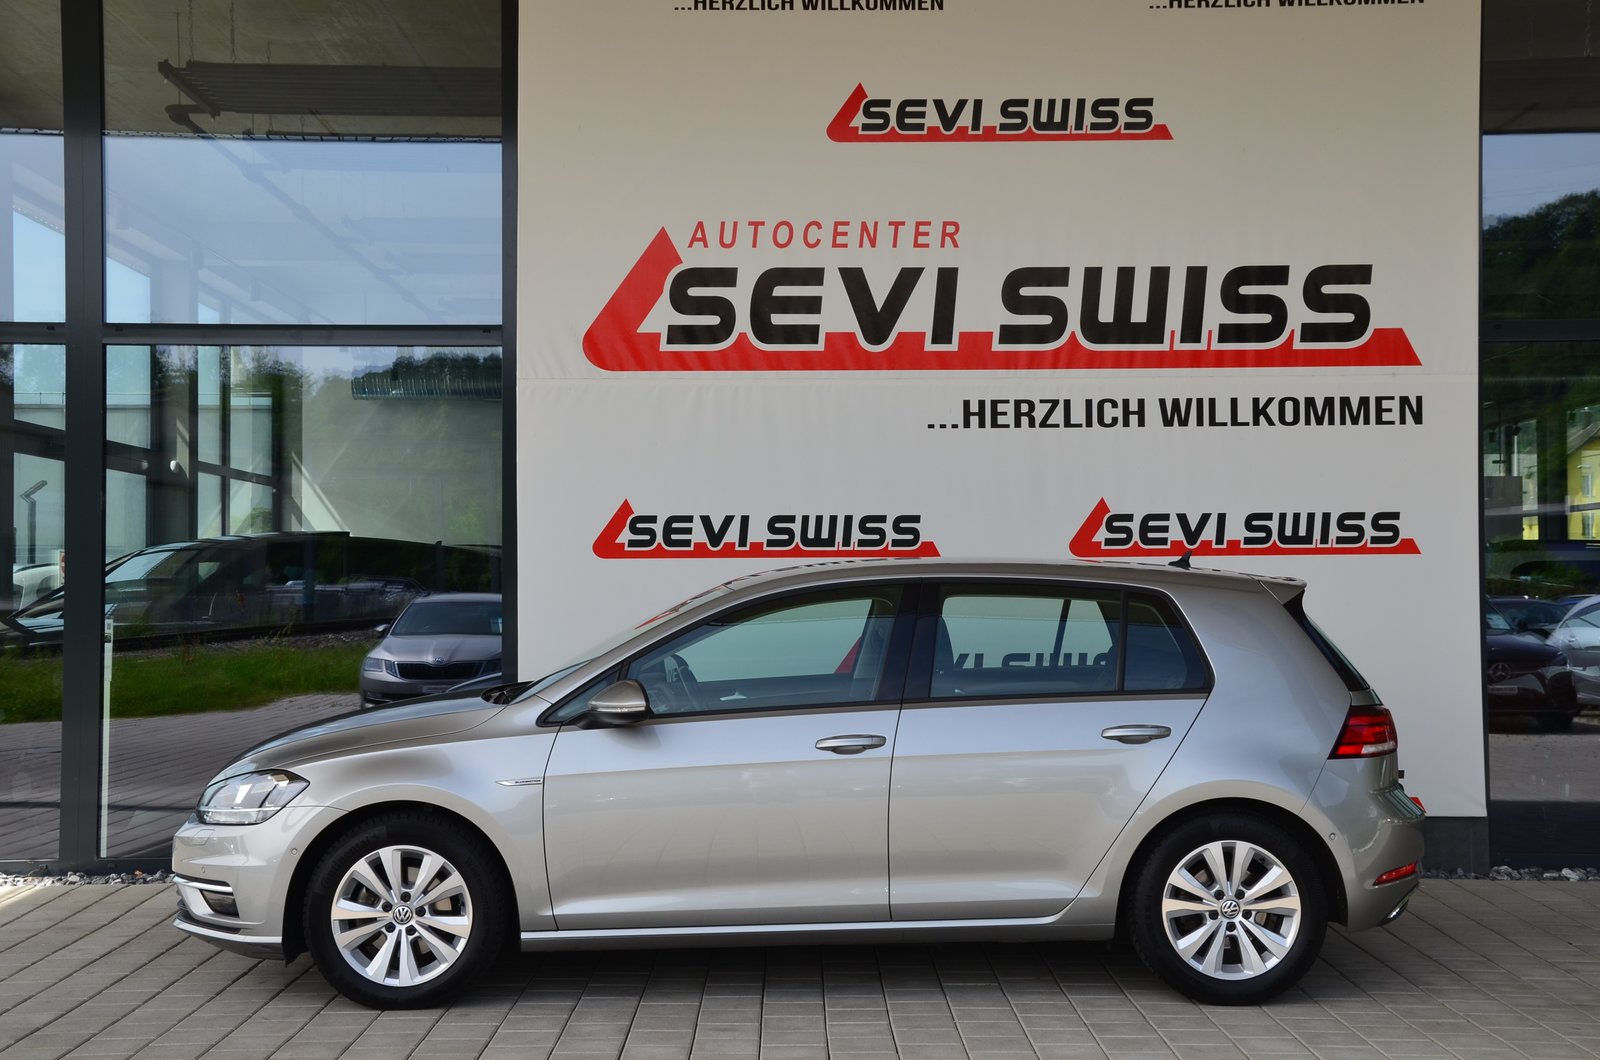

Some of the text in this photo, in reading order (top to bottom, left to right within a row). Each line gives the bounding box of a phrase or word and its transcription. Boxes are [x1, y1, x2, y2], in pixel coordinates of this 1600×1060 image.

[861, 98, 1154, 132] SEVI SWISS
[687, 220, 961, 249] AUTOCENTER
[666, 264, 1373, 346] SEVI SWISS
[927, 395, 1423, 429] ...HERZLICH WILLKOMMEN
[627, 514, 922, 548] SEVI SWISS
[1103, 511, 1401, 547] SEVI SWISS
